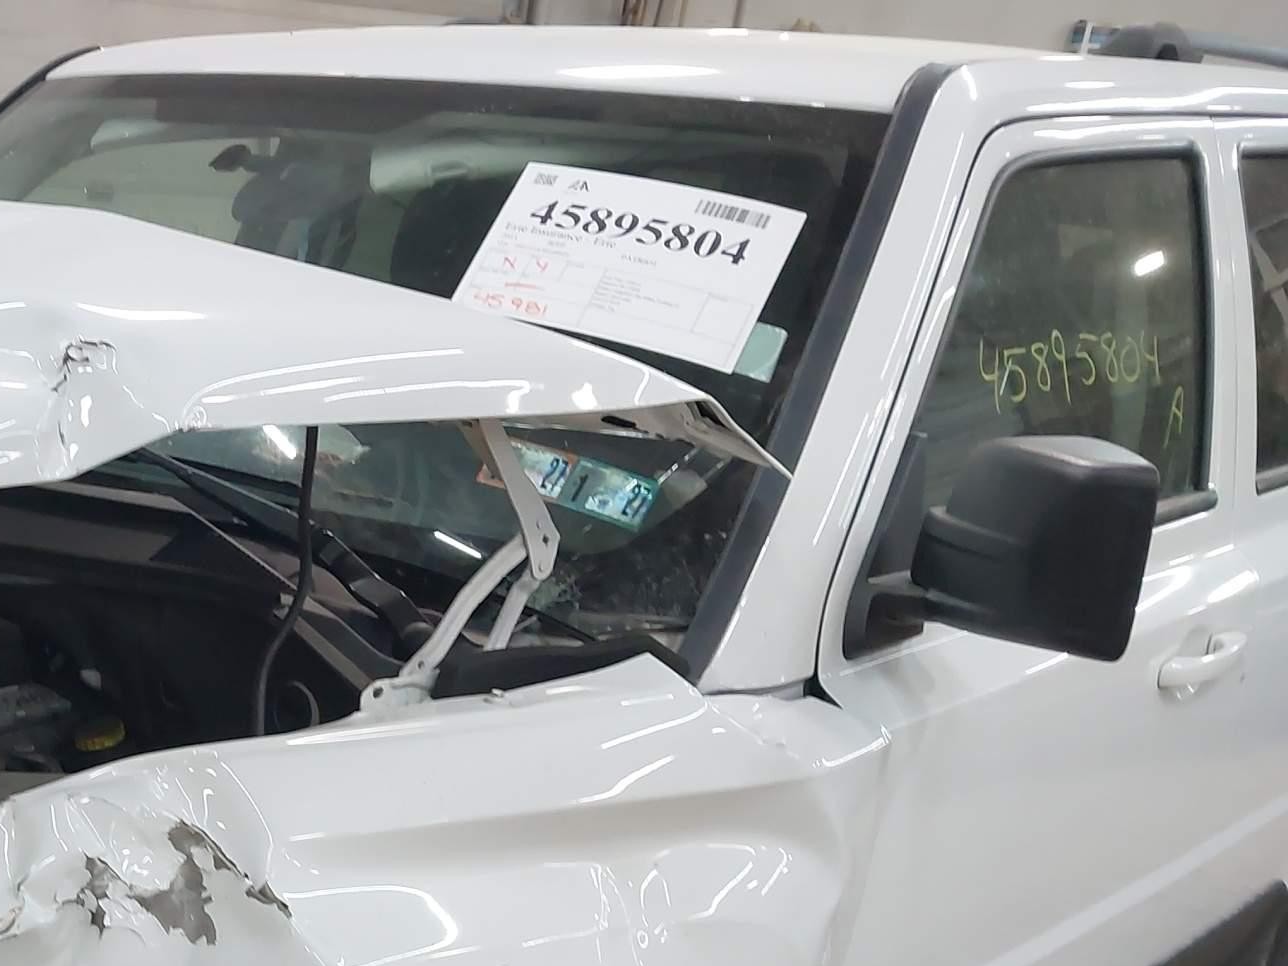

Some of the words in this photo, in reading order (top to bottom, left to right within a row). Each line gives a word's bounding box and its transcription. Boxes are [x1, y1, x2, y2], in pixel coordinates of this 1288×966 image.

[530, 199, 752, 267] 45895804
[978, 329, 1162, 414] 45895804
[1163, 385, 1185, 449] A
